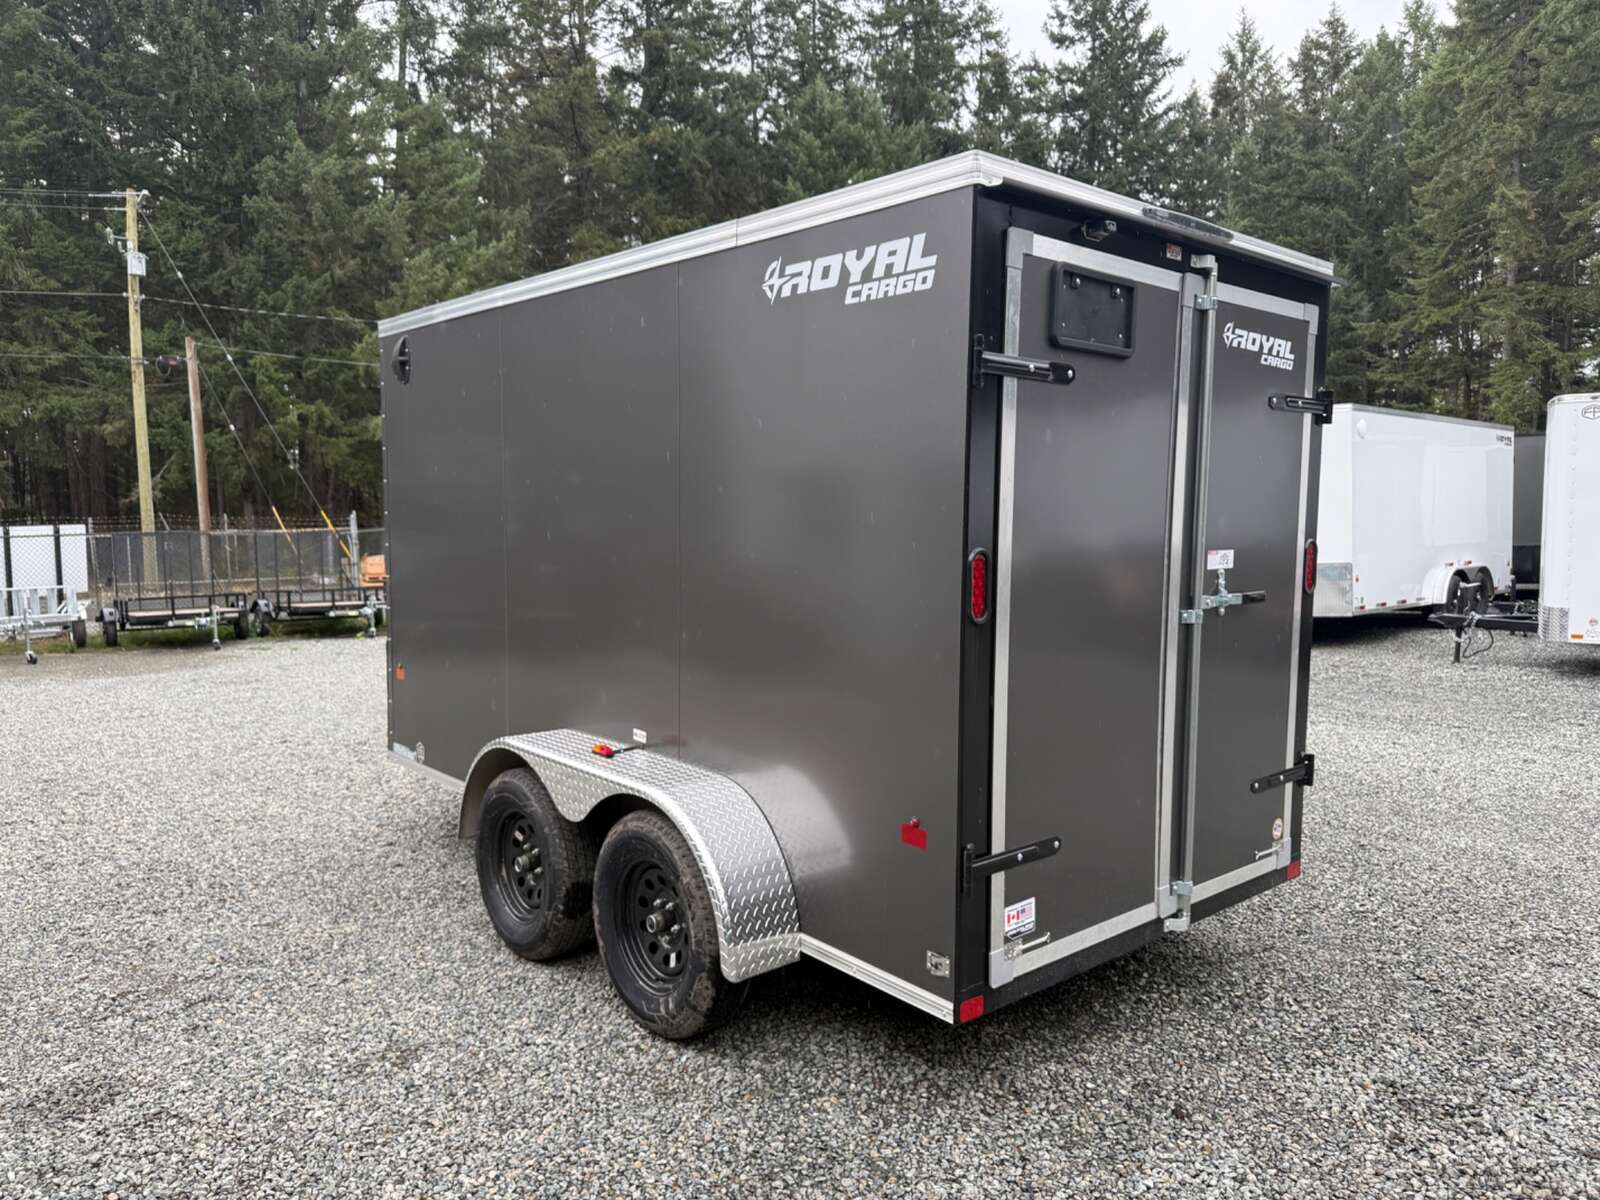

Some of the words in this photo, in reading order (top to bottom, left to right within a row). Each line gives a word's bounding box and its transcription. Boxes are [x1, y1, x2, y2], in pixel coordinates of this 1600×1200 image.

[780, 232, 938, 298] ROYAL
[845, 269, 936, 305] CARGO
[1231, 328, 1295, 360] ROYAL
[1260, 354, 1295, 371] CARGO
